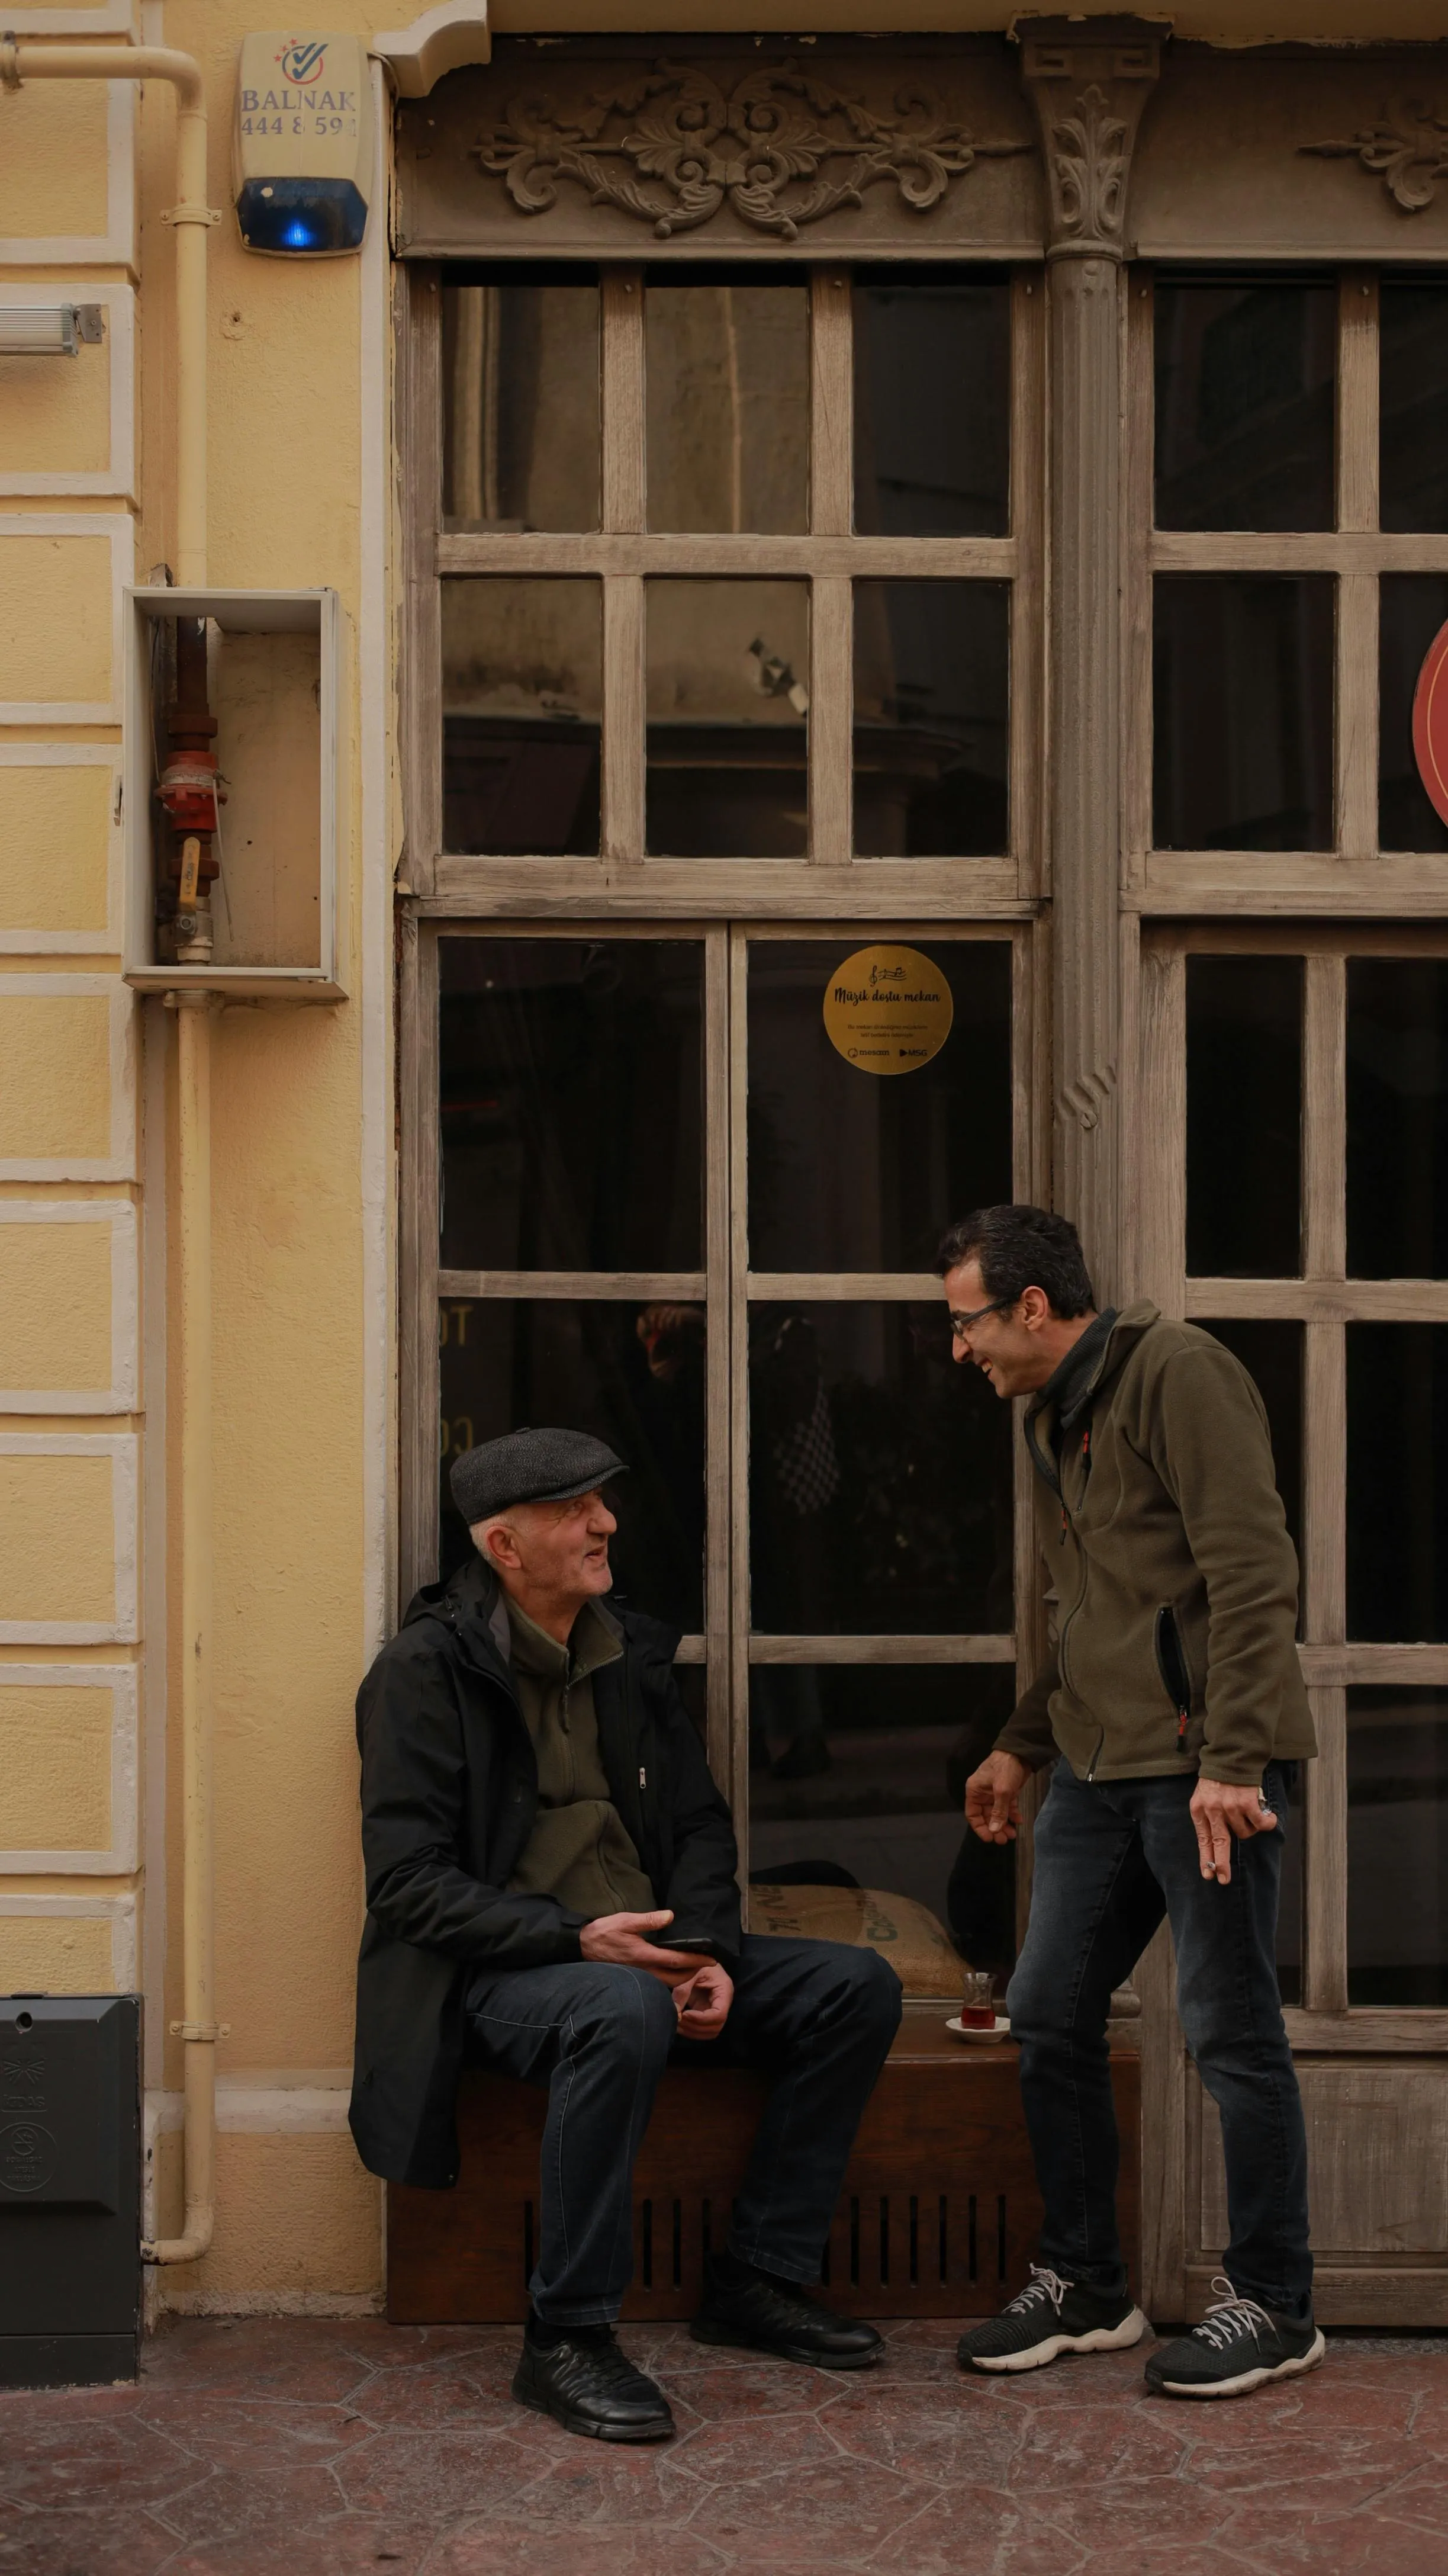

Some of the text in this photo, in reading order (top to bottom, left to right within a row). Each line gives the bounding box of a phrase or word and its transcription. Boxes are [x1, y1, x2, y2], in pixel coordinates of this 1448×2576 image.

[242, 90, 356, 112] BALNAK
[242, 117, 283, 135] 444
[292, 117, 305, 135] 8
[835, 987, 941, 1006] Müzik dostu mekan
